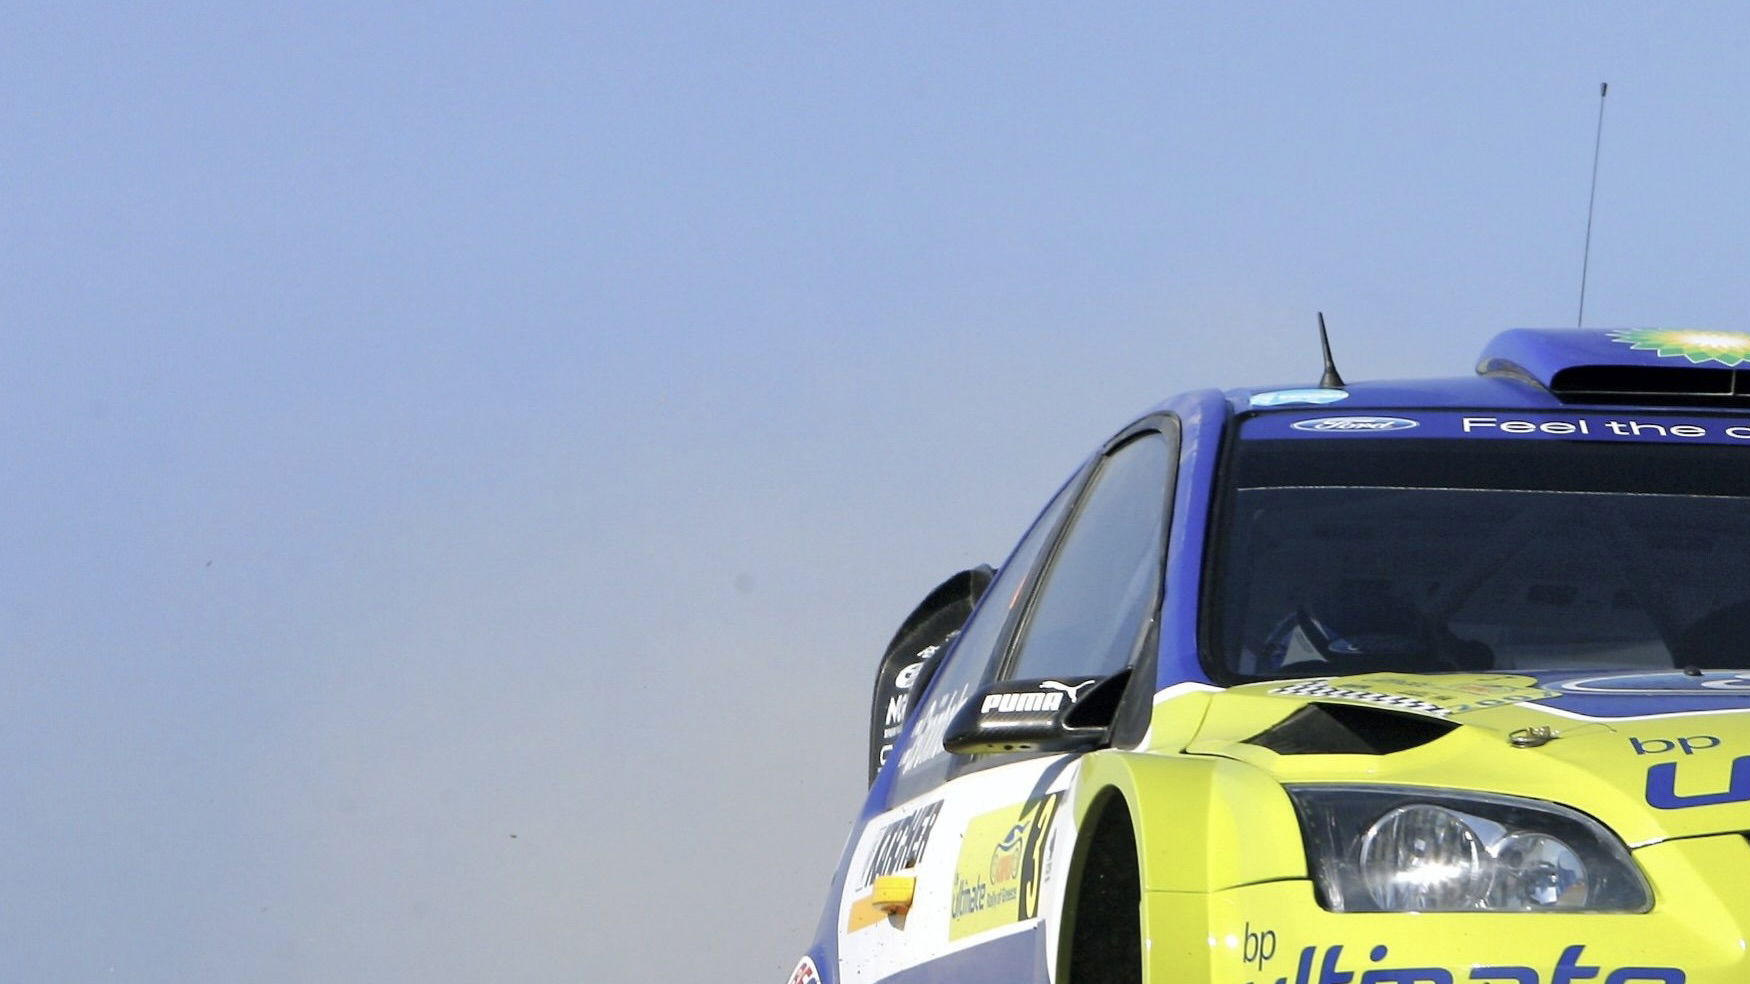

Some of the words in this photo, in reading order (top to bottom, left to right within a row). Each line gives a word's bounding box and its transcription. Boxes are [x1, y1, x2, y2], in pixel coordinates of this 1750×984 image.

[1462, 417, 1589, 435] Feel
[1605, 420, 1706, 438] the
[980, 692, 1064, 714] PUMA
[1629, 735, 1721, 755] bp
[1244, 923, 1276, 970] bp
